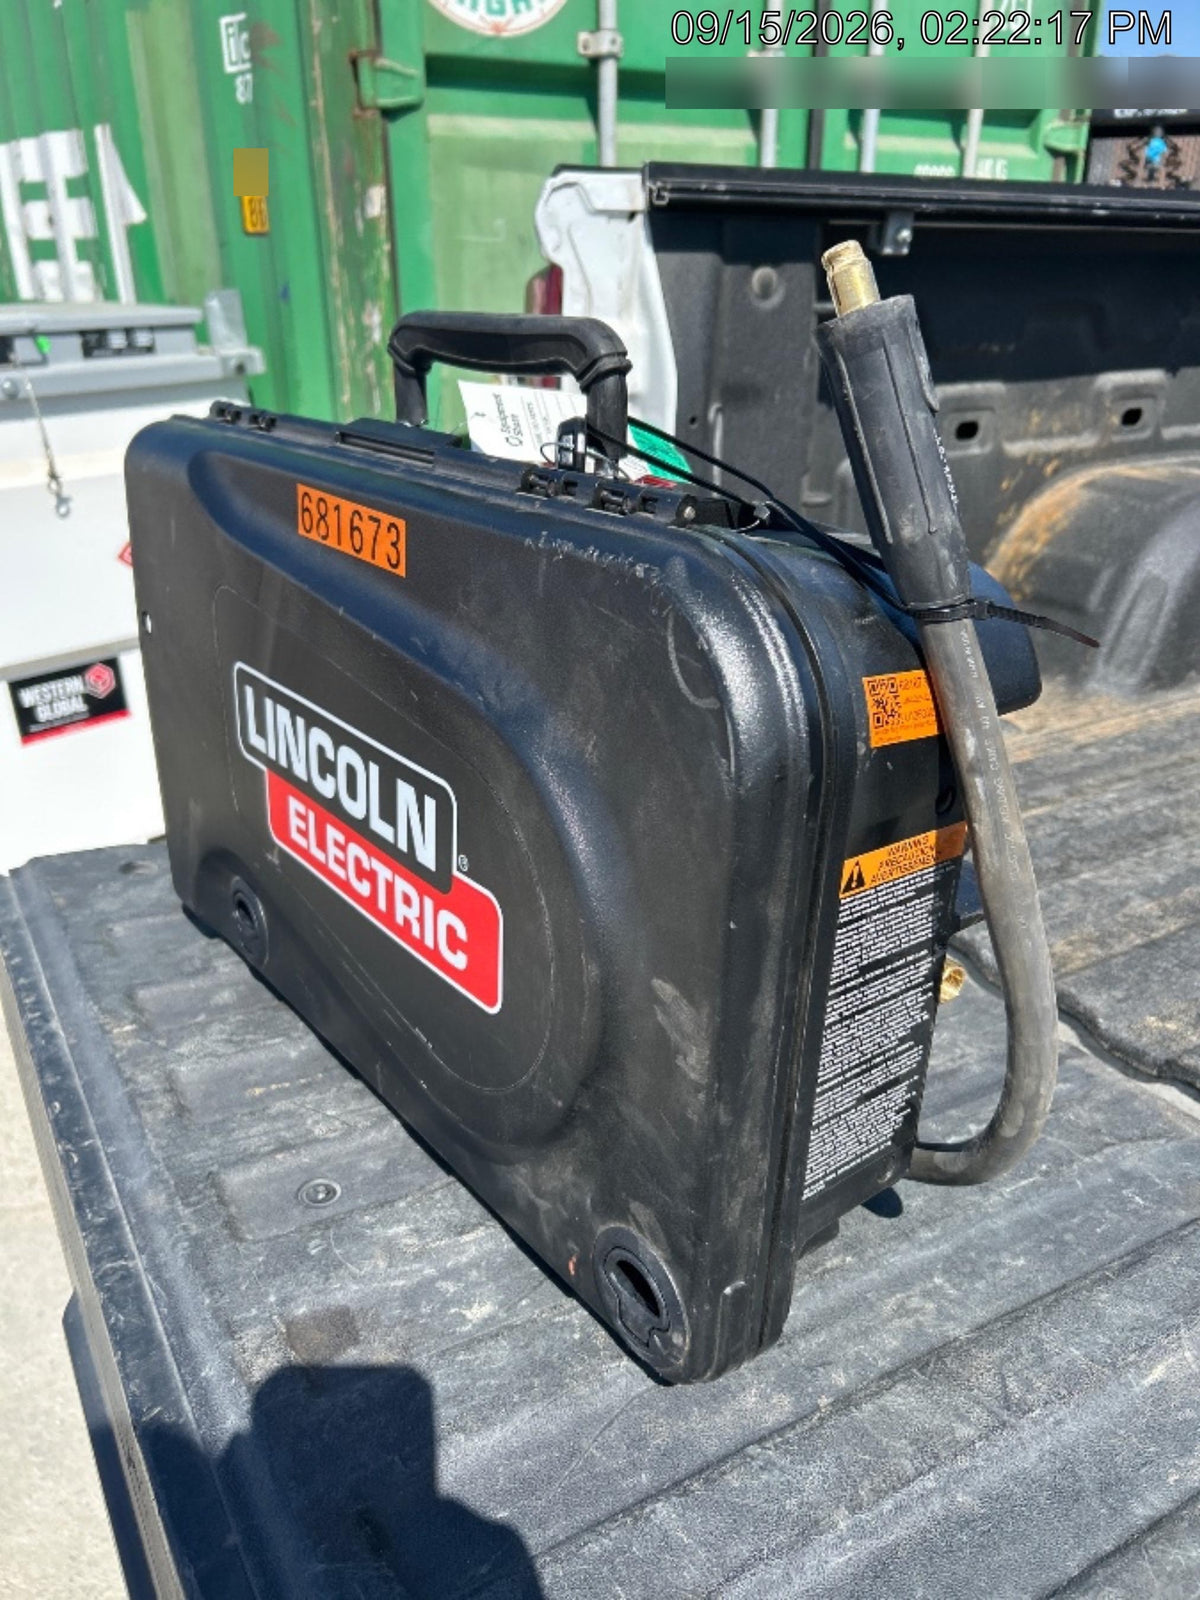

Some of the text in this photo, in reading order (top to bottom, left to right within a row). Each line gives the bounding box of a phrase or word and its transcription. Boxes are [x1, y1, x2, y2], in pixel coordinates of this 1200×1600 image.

[301, 491, 401, 570] 681673
[244, 684, 437, 873] LINCOLN
[287, 794, 468, 971] ELECTRIC
